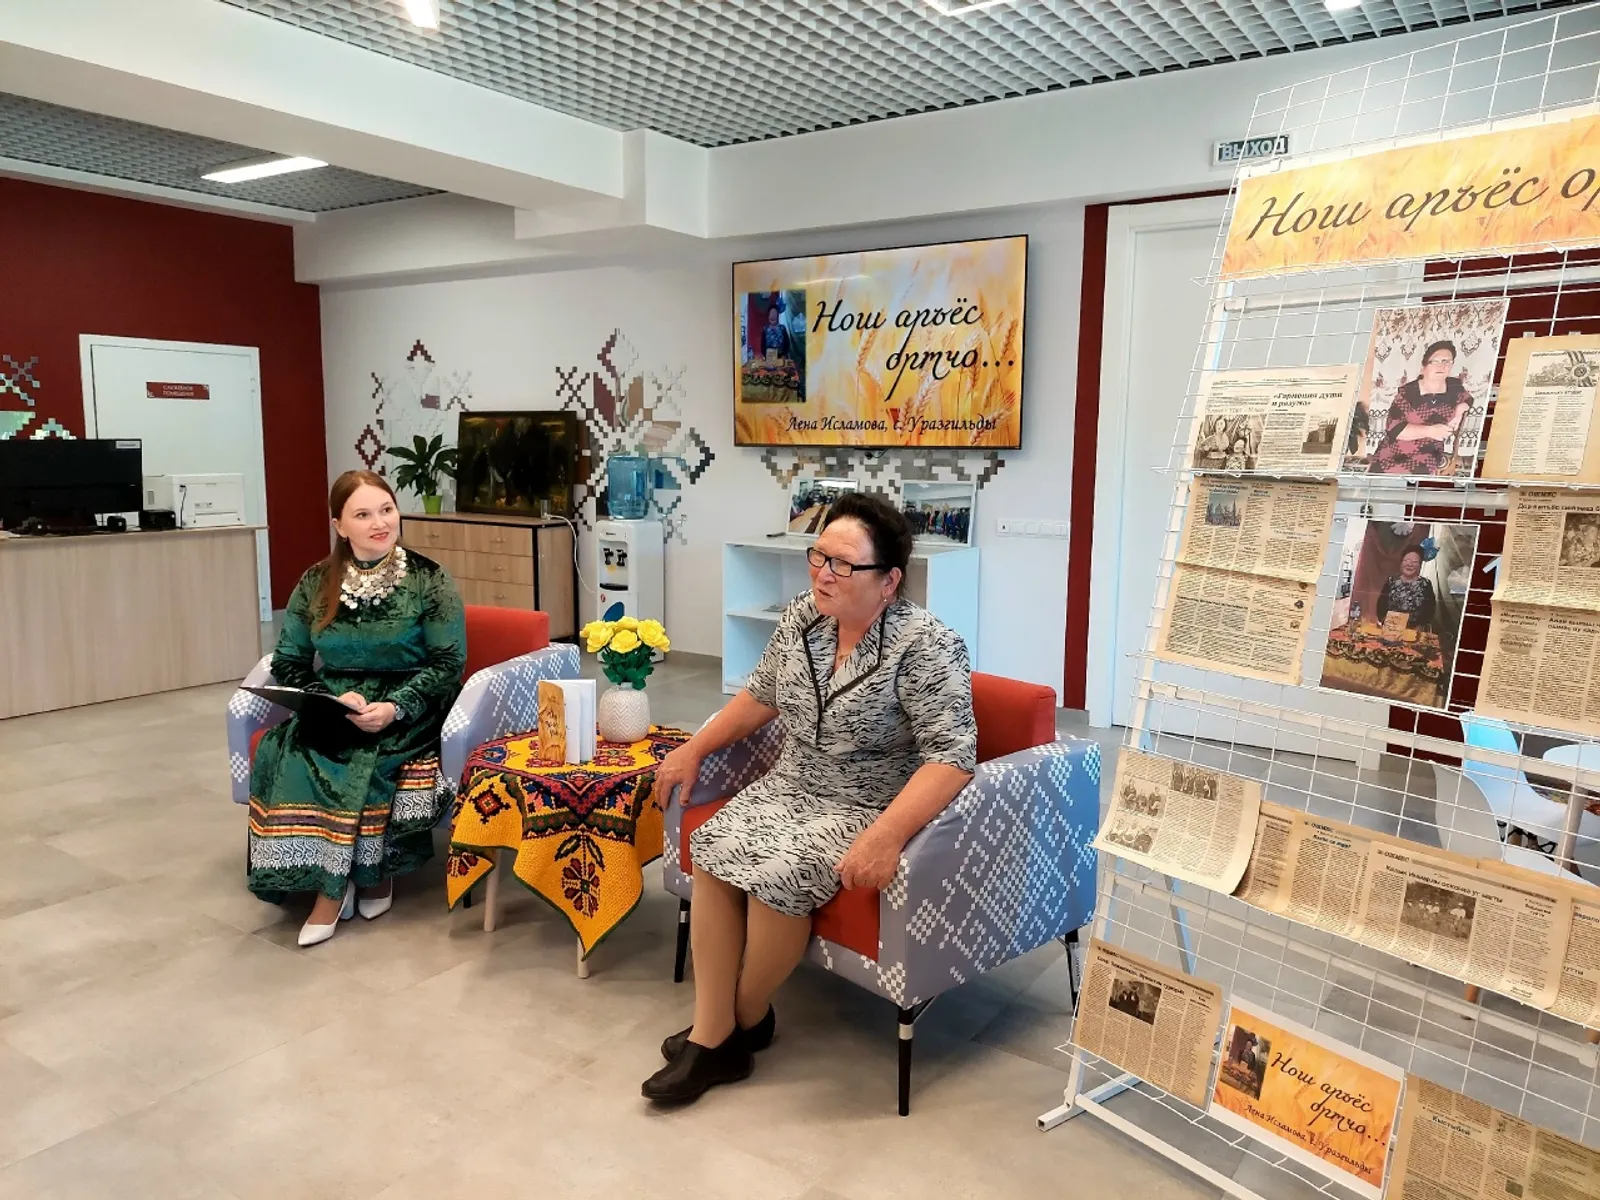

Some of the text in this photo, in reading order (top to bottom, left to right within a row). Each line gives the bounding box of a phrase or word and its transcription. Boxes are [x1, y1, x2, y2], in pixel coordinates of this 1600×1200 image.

[1222, 138, 1286, 160] ВЫХОД
[1246, 191, 1373, 241] Нош
[1384, 166, 1550, 232] аръёс
[812, 299, 886, 333] Нош
[821, 413, 889, 433] Исламова,
[906, 415, 997, 434] Уразгильды
[1271, 1052, 1316, 1086] Нош
